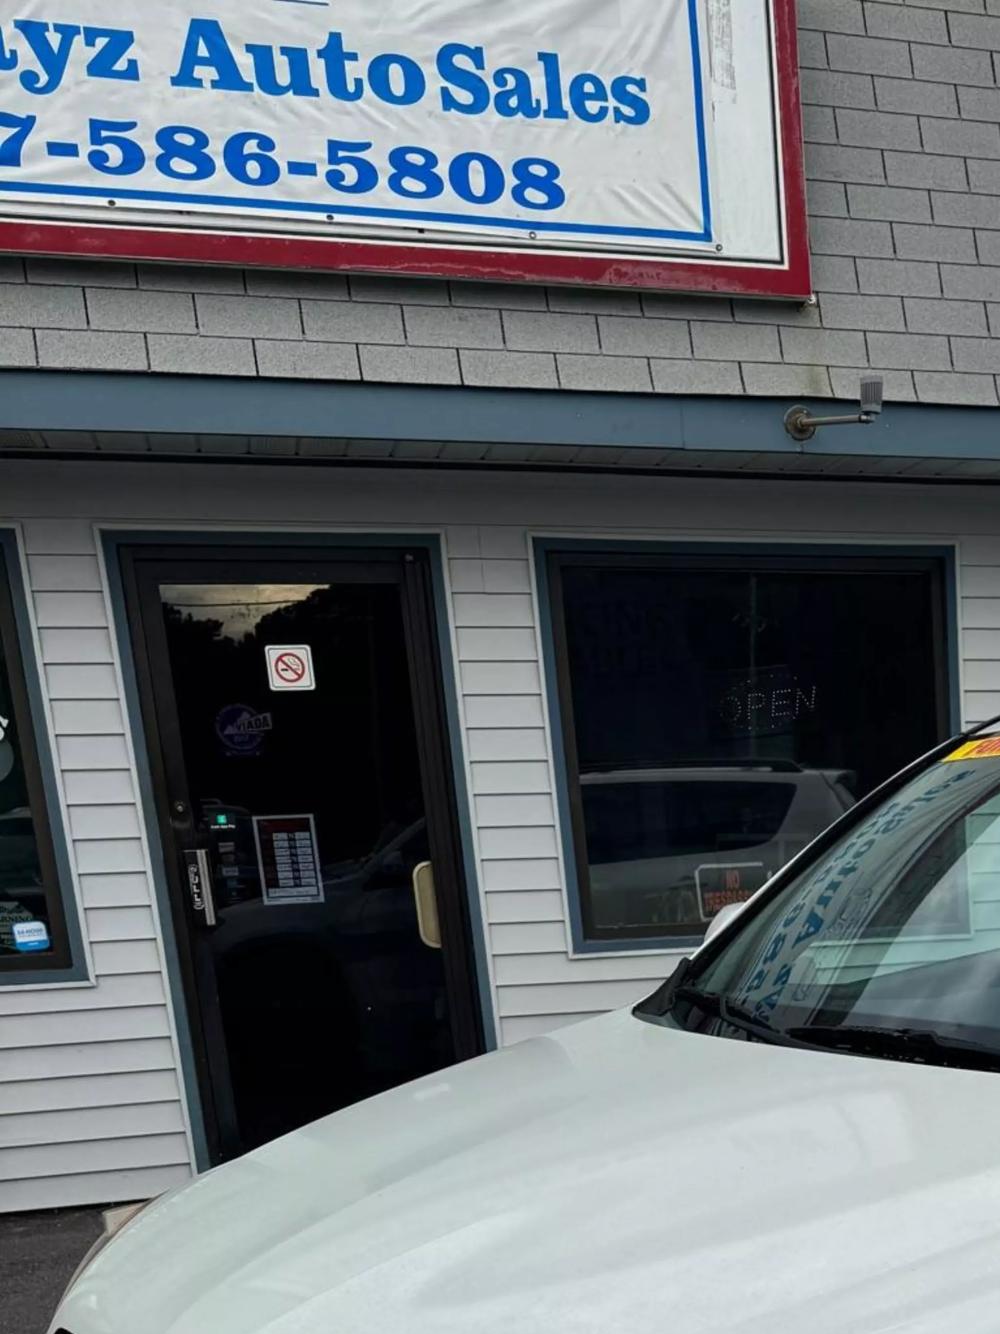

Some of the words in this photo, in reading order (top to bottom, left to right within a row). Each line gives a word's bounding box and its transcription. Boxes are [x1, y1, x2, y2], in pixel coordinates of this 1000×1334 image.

[171, 19, 426, 106] Auto
[436, 43, 651, 126] Sales
[719, 685, 817, 722] OPEN
